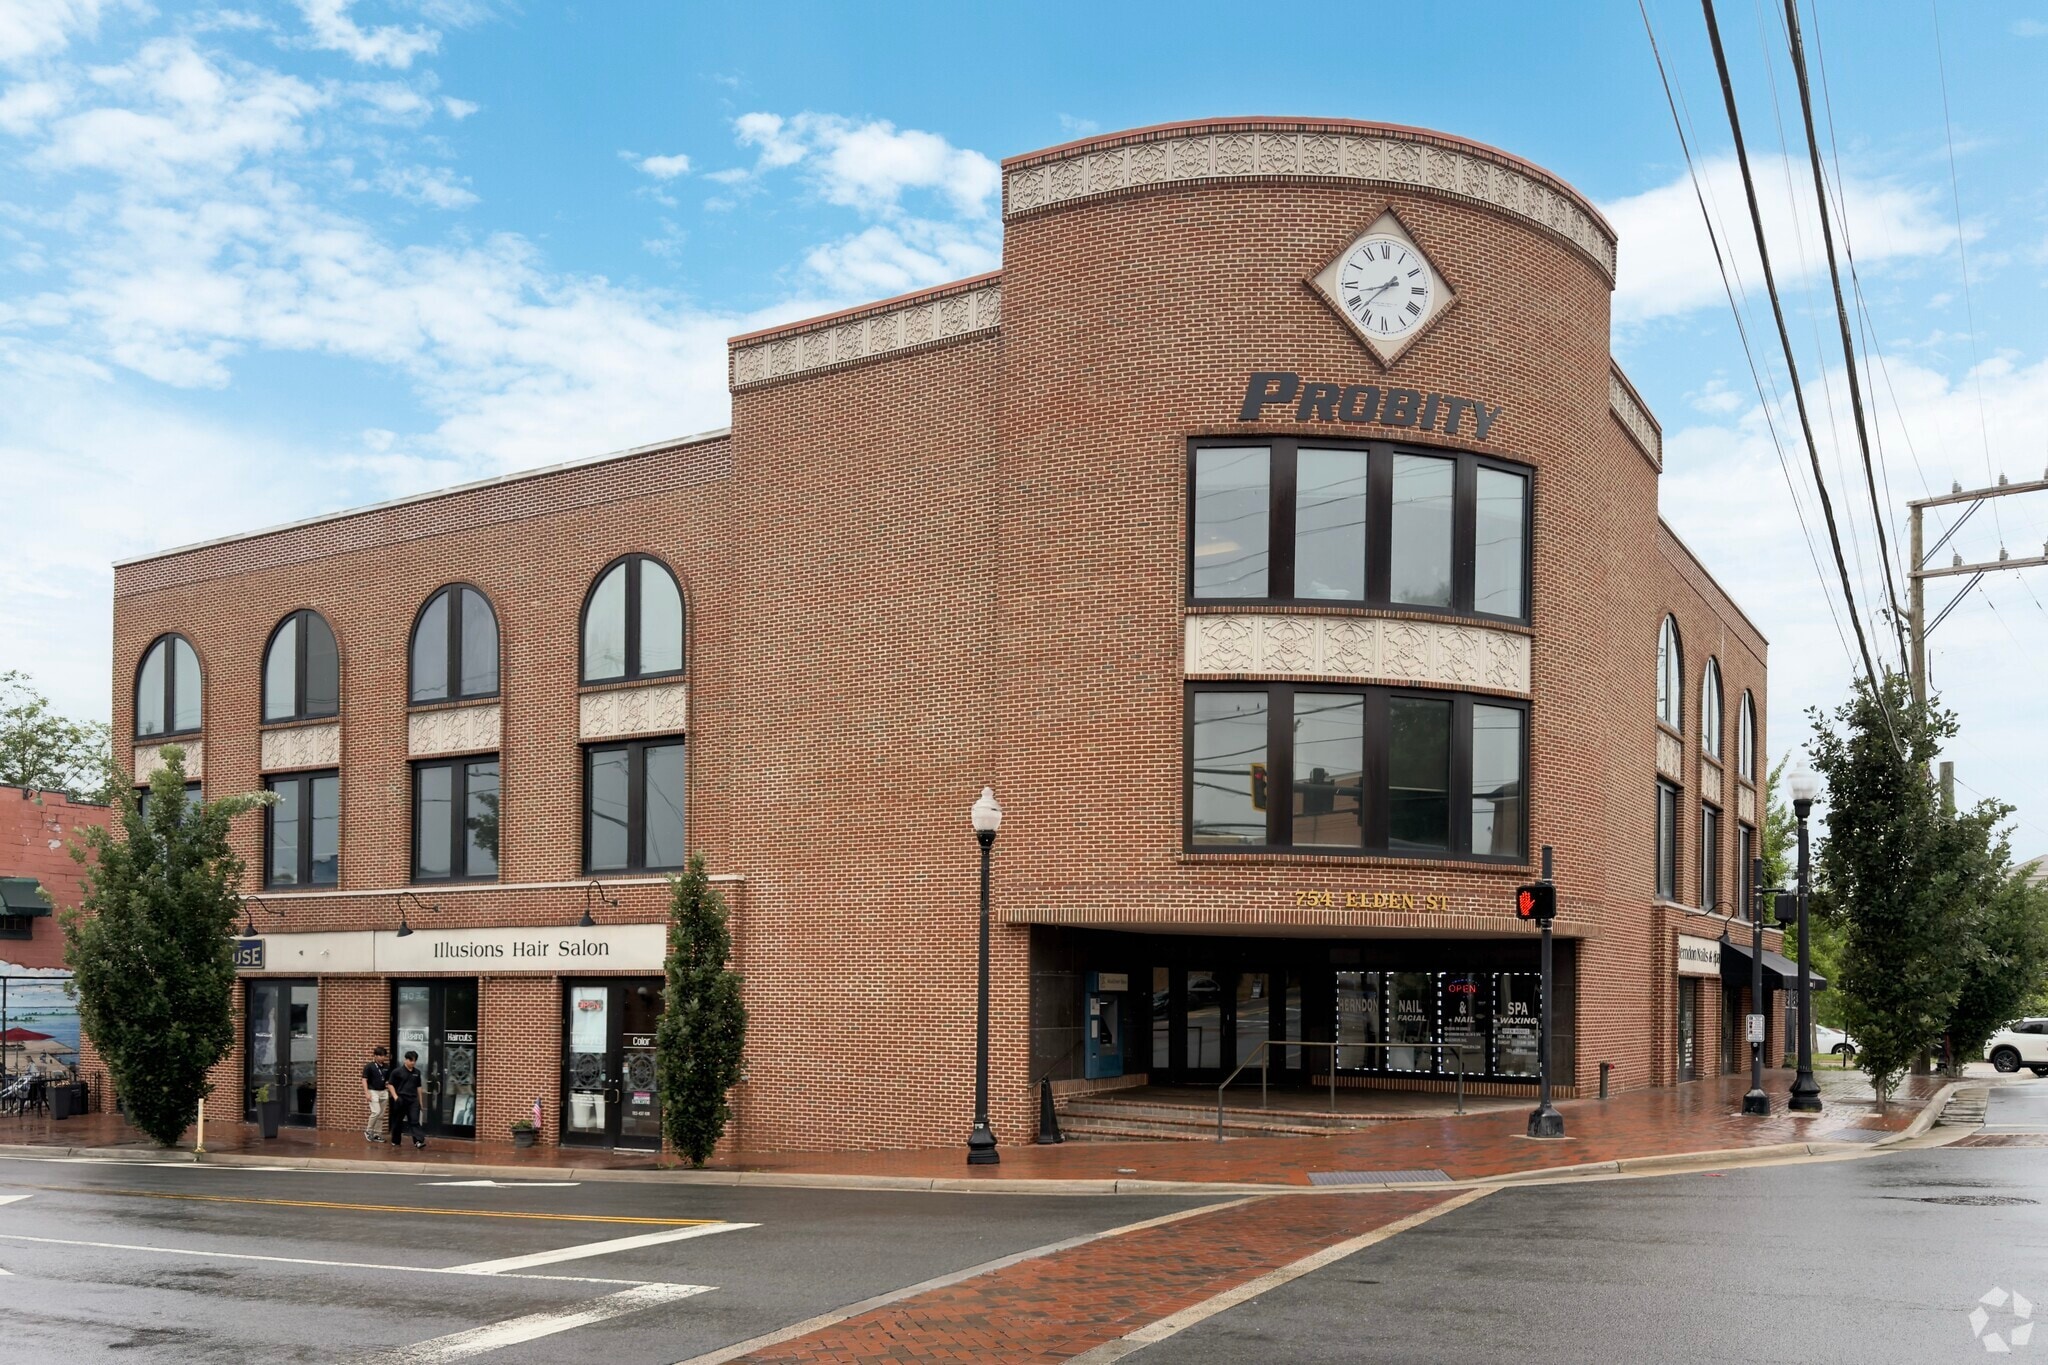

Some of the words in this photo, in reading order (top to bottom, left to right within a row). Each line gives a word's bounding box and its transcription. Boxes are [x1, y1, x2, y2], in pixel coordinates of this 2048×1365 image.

[1238, 371, 1501, 440] PROBITY
[1295, 891, 1333, 907] 754
[1345, 891, 1414, 909] ELDEN
[1426, 894, 1450, 911] ST
[232, 946, 261, 965] USE
[434, 942, 504, 958] Illusions
[512, 940, 550, 957] Hair
[558, 939, 610, 957] Salon
[1679, 945, 1697, 960] erndon
[1448, 984, 1476, 993] OPEN
[1339, 998, 1378, 1012] HERNDON
[1398, 999, 1423, 1013] NAIL
[1459, 1001, 1466, 1014] &
[1507, 1002, 1528, 1015] SPA
[1397, 1014, 1427, 1022] FACIAL
[1500, 1016, 1537, 1025] WAXING
[447, 1032, 473, 1042] Haircuts
[632, 1036, 651, 1046] Color
